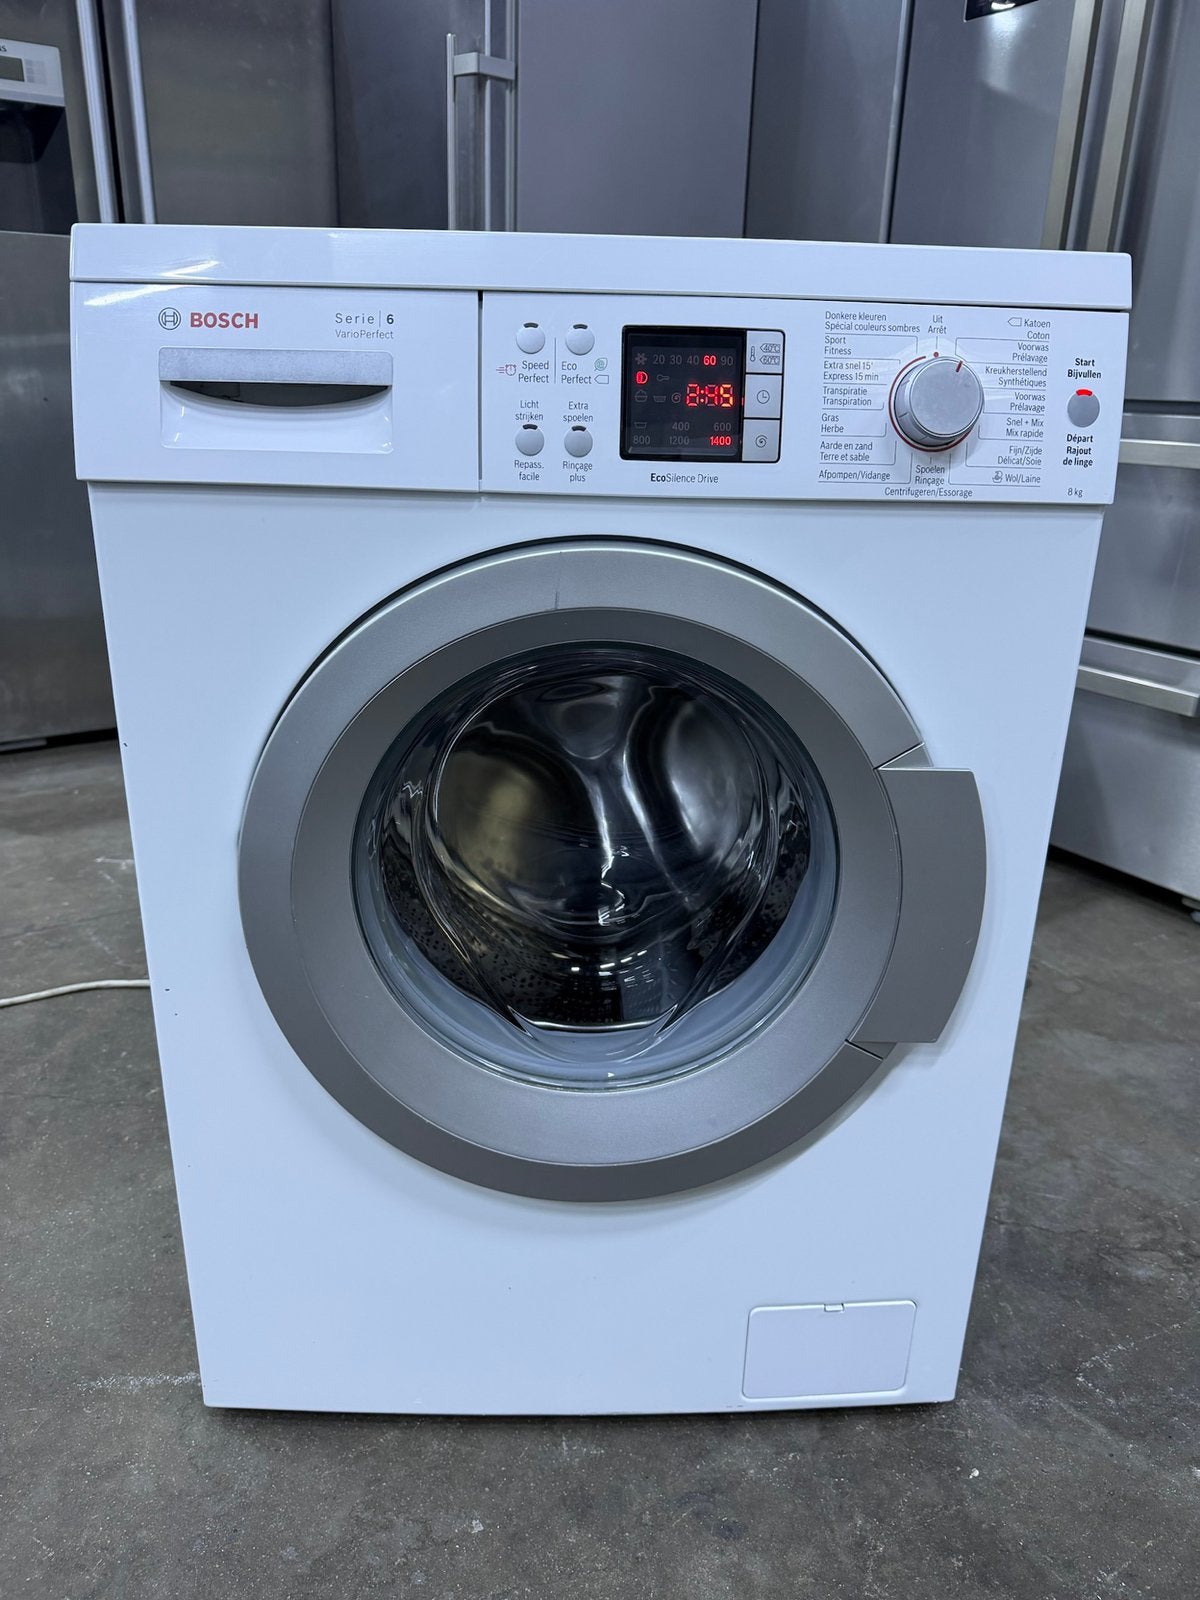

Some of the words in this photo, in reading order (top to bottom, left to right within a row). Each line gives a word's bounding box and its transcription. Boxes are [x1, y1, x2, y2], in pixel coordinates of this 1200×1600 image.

[190, 313, 259, 329] BOSCH
[335, 313, 375, 324] Serie
[387, 315, 394, 324] 6
[825, 311, 857, 321] Donkere
[859, 312, 886, 321] kleuren
[933, 315, 942, 323] Uit
[825, 321, 853, 331] Spécial
[854, 323, 886, 331] couleurs
[1024, 319, 1050, 328] Katoen
[336, 330, 393, 339] VarioPerfect
[928, 325, 946, 334] Arrêt
[825, 336, 846, 345] Sport
[1027, 331, 1050, 340] Coton
[824, 347, 851, 355] Fitness
[1018, 343, 1049, 351] Voorwas
[652, 355, 666, 364] 20
[670, 355, 682, 365] 30
[687, 355, 700, 365] 40
[703, 354, 716, 366] 60
[720, 356, 734, 366] 90
[1012, 353, 1047, 363] Prélavage
[1075, 358, 1094, 367] Start
[522, 361, 549, 371] Speed
[562, 362, 577, 370] Eco
[824, 361, 843, 370] Extra
[845, 361, 861, 370] snel
[986, 366, 1047, 376] Kreukherstellend
[1068, 370, 1101, 379] Bijvullen
[518, 374, 550, 384] Perfect
[561, 375, 592, 384] Perfect
[823, 372, 853, 381] Express
[855, 372, 863, 380] 15
[864, 373, 878, 381] min
[999, 377, 1046, 387] Synthétiques
[686, 383, 734, 408] 2:45
[823, 386, 867, 396] Transpiratie
[823, 397, 872, 406] Transpiration
[1015, 392, 1045, 401] Voorwas
[520, 400, 539, 409] Licht
[568, 401, 588, 410] Extra
[1010, 403, 1045, 412] Prélavage
[515, 412, 544, 422] strijken
[563, 413, 594, 423] spoelen
[822, 413, 839, 421] Gras
[672, 422, 690, 431] 400
[713, 422, 732, 432] 600
[1007, 418, 1023, 426] Snel
[1031, 419, 1043, 427] Mix
[821, 424, 844, 433] Herbe
[1006, 428, 1018, 436] Mix
[1020, 429, 1043, 439] rapide
[633, 435, 650, 444] 800
[669, 436, 690, 445] 1200
[710, 436, 732, 446] 1400
[1067, 434, 1093, 443] Départ
[820, 441, 842, 450] Aarde
[855, 442, 873, 450] zand
[1009, 445, 1042, 456] Fijn/Zijde
[1066, 446, 1091, 456] Rajout
[820, 453, 839, 461] Terre
[841, 453, 848, 461] et
[850, 453, 870, 461] sable
[998, 456, 1042, 465] Délicat/Soie
[514, 460, 544, 470] Repass.
[562, 461, 592, 472] Rinçage
[1074, 458, 1093, 467] linge
[819, 470, 891, 480] Afpompen/Vidange
[916, 465, 945, 475] Spoelen
[518, 472, 540, 481] facile
[570, 473, 586, 483] plus
[650, 473, 696, 484] EcoSilence
[698, 474, 718, 484] Drive
[915, 476, 944, 486] Rinçage
[1005, 473, 1040, 483] Wol/Laine
[885, 487, 972, 498] Centrifugeren/Essorage
[1068, 488, 1073, 496] 8
[1074, 488, 1083, 498] kg
